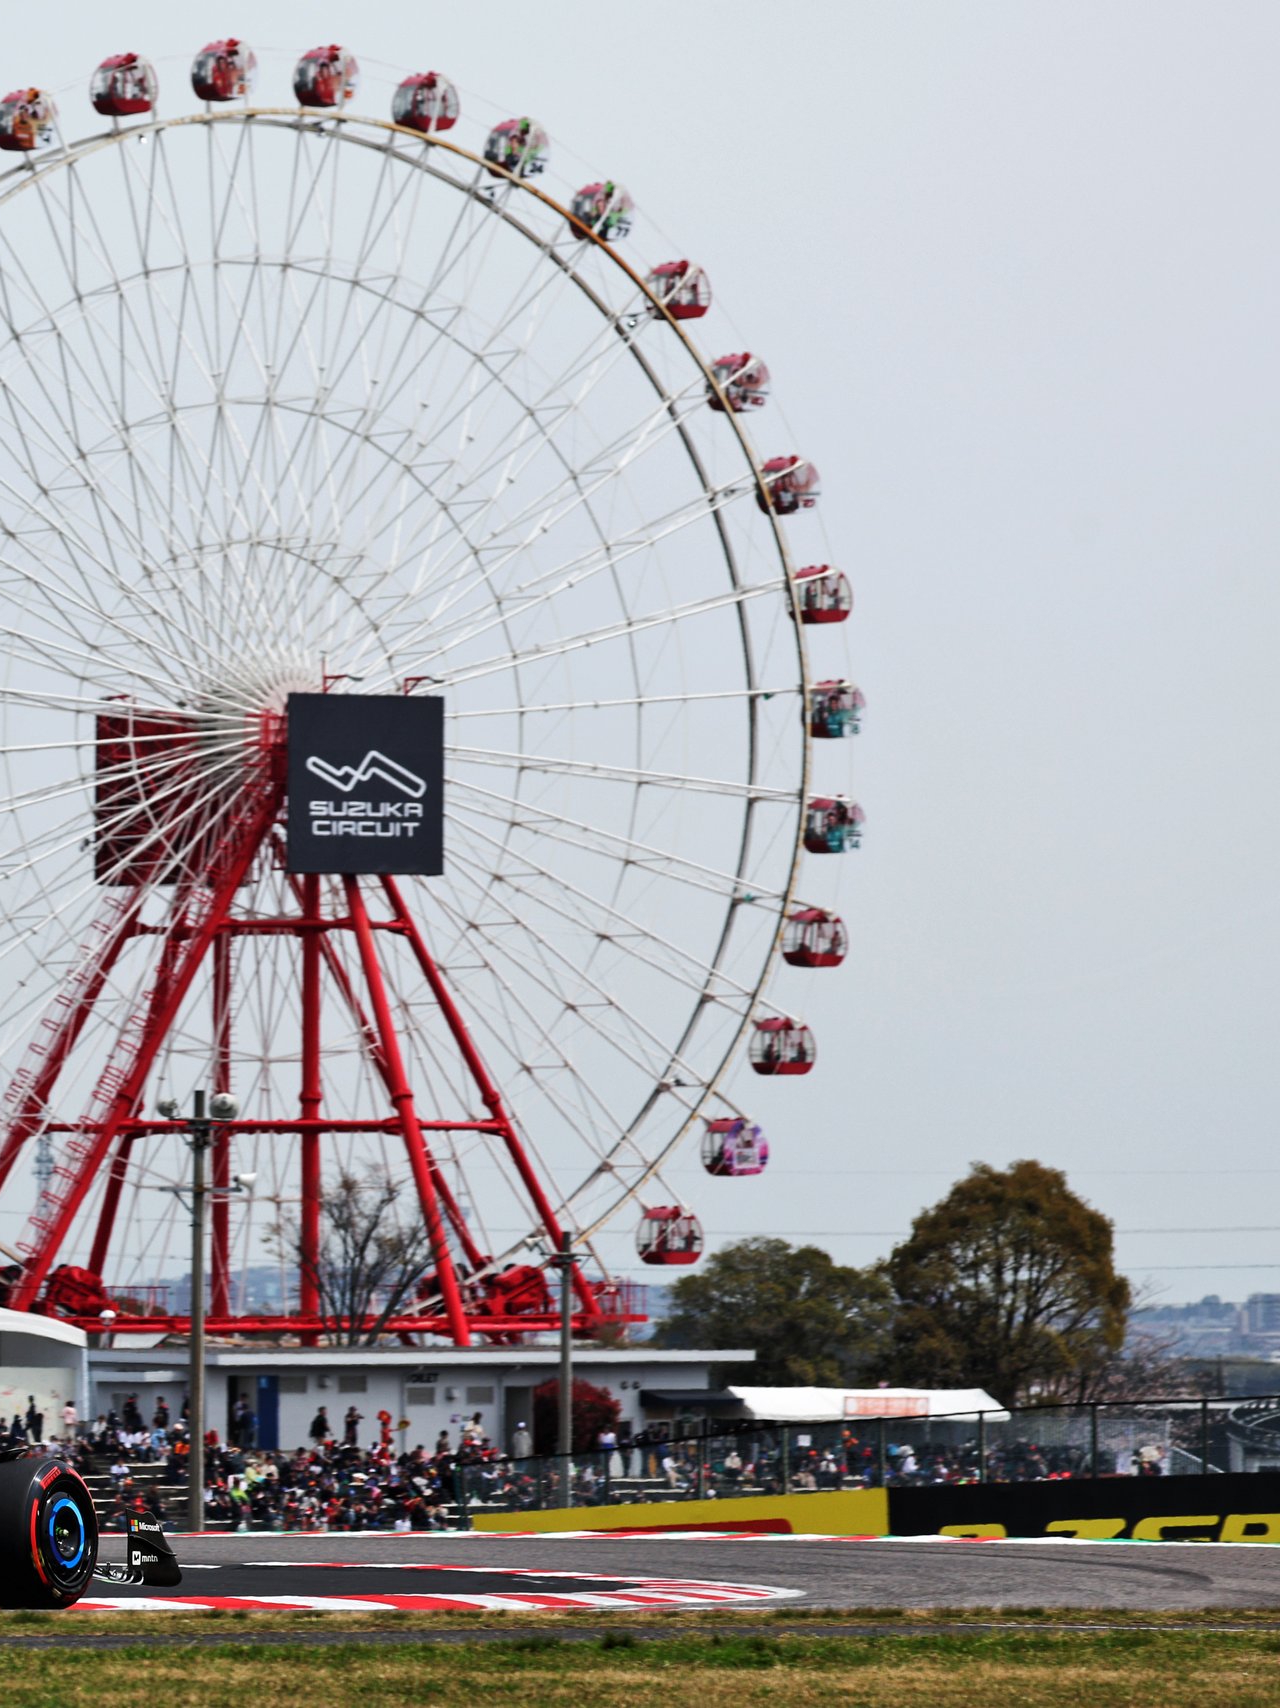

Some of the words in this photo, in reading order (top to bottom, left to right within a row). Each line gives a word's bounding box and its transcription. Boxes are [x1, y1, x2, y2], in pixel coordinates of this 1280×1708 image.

[309, 801, 423, 817] SUZUKA
[312, 820, 420, 837] CIRCUIT
[139, 1522, 161, 1532] Microsoft
[141, 1553, 159, 1563] mntn
